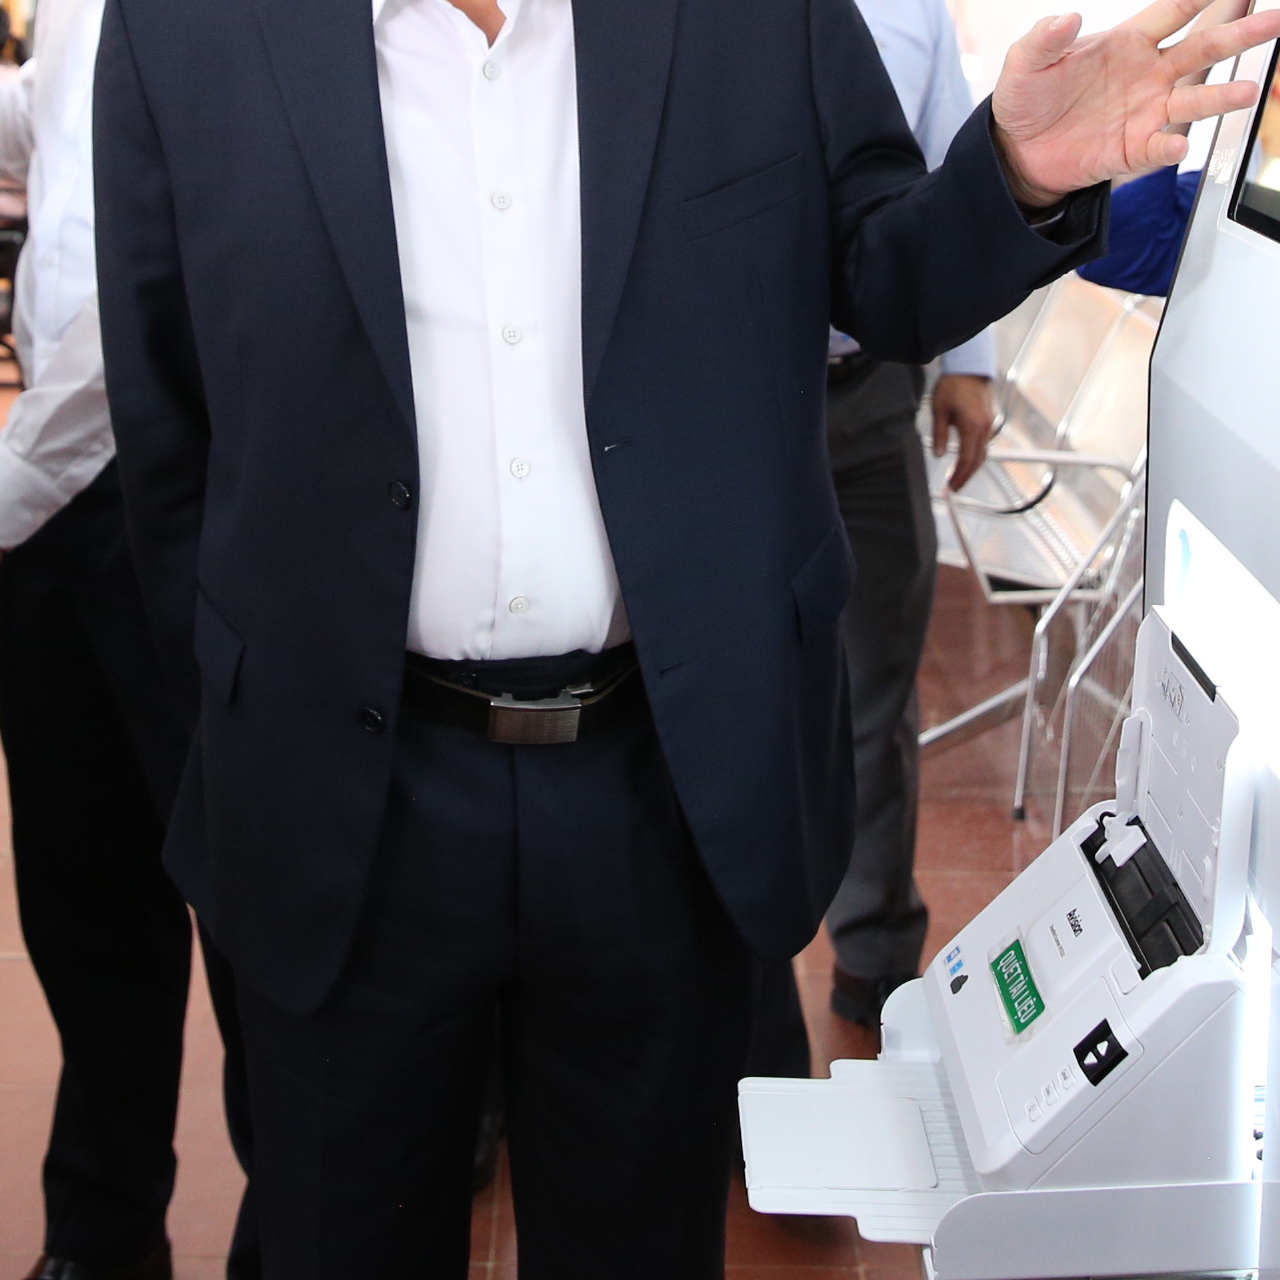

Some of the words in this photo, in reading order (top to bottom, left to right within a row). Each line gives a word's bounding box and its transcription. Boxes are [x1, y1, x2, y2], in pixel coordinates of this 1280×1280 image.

[997, 950, 1022, 983] QUÉT
[1009, 974, 1028, 1000] TÀI
[1014, 990, 1037, 1023] LIỆU
